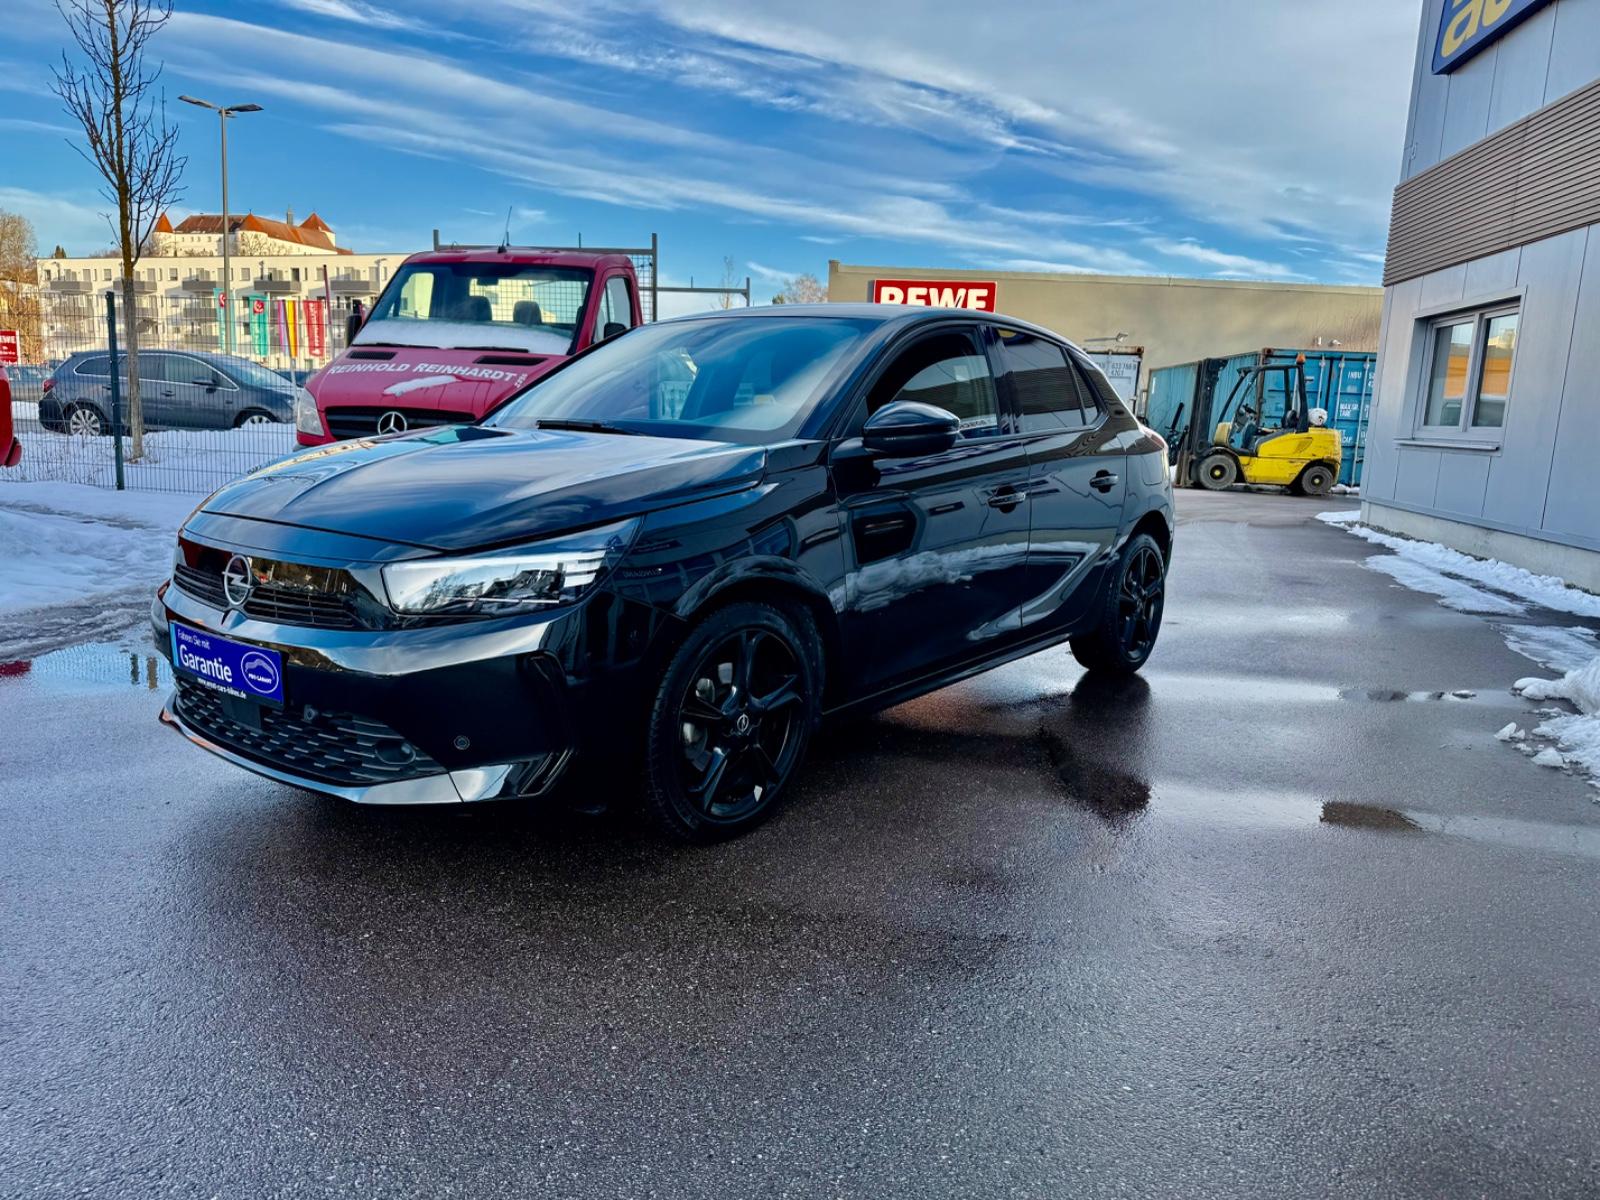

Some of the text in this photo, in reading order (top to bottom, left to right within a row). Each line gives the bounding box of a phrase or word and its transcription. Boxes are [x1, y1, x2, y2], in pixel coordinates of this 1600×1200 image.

[328, 363, 410, 375] REINHOLD
[412, 362, 517, 382] REINHARDT
[179, 644, 233, 683] Garantie
